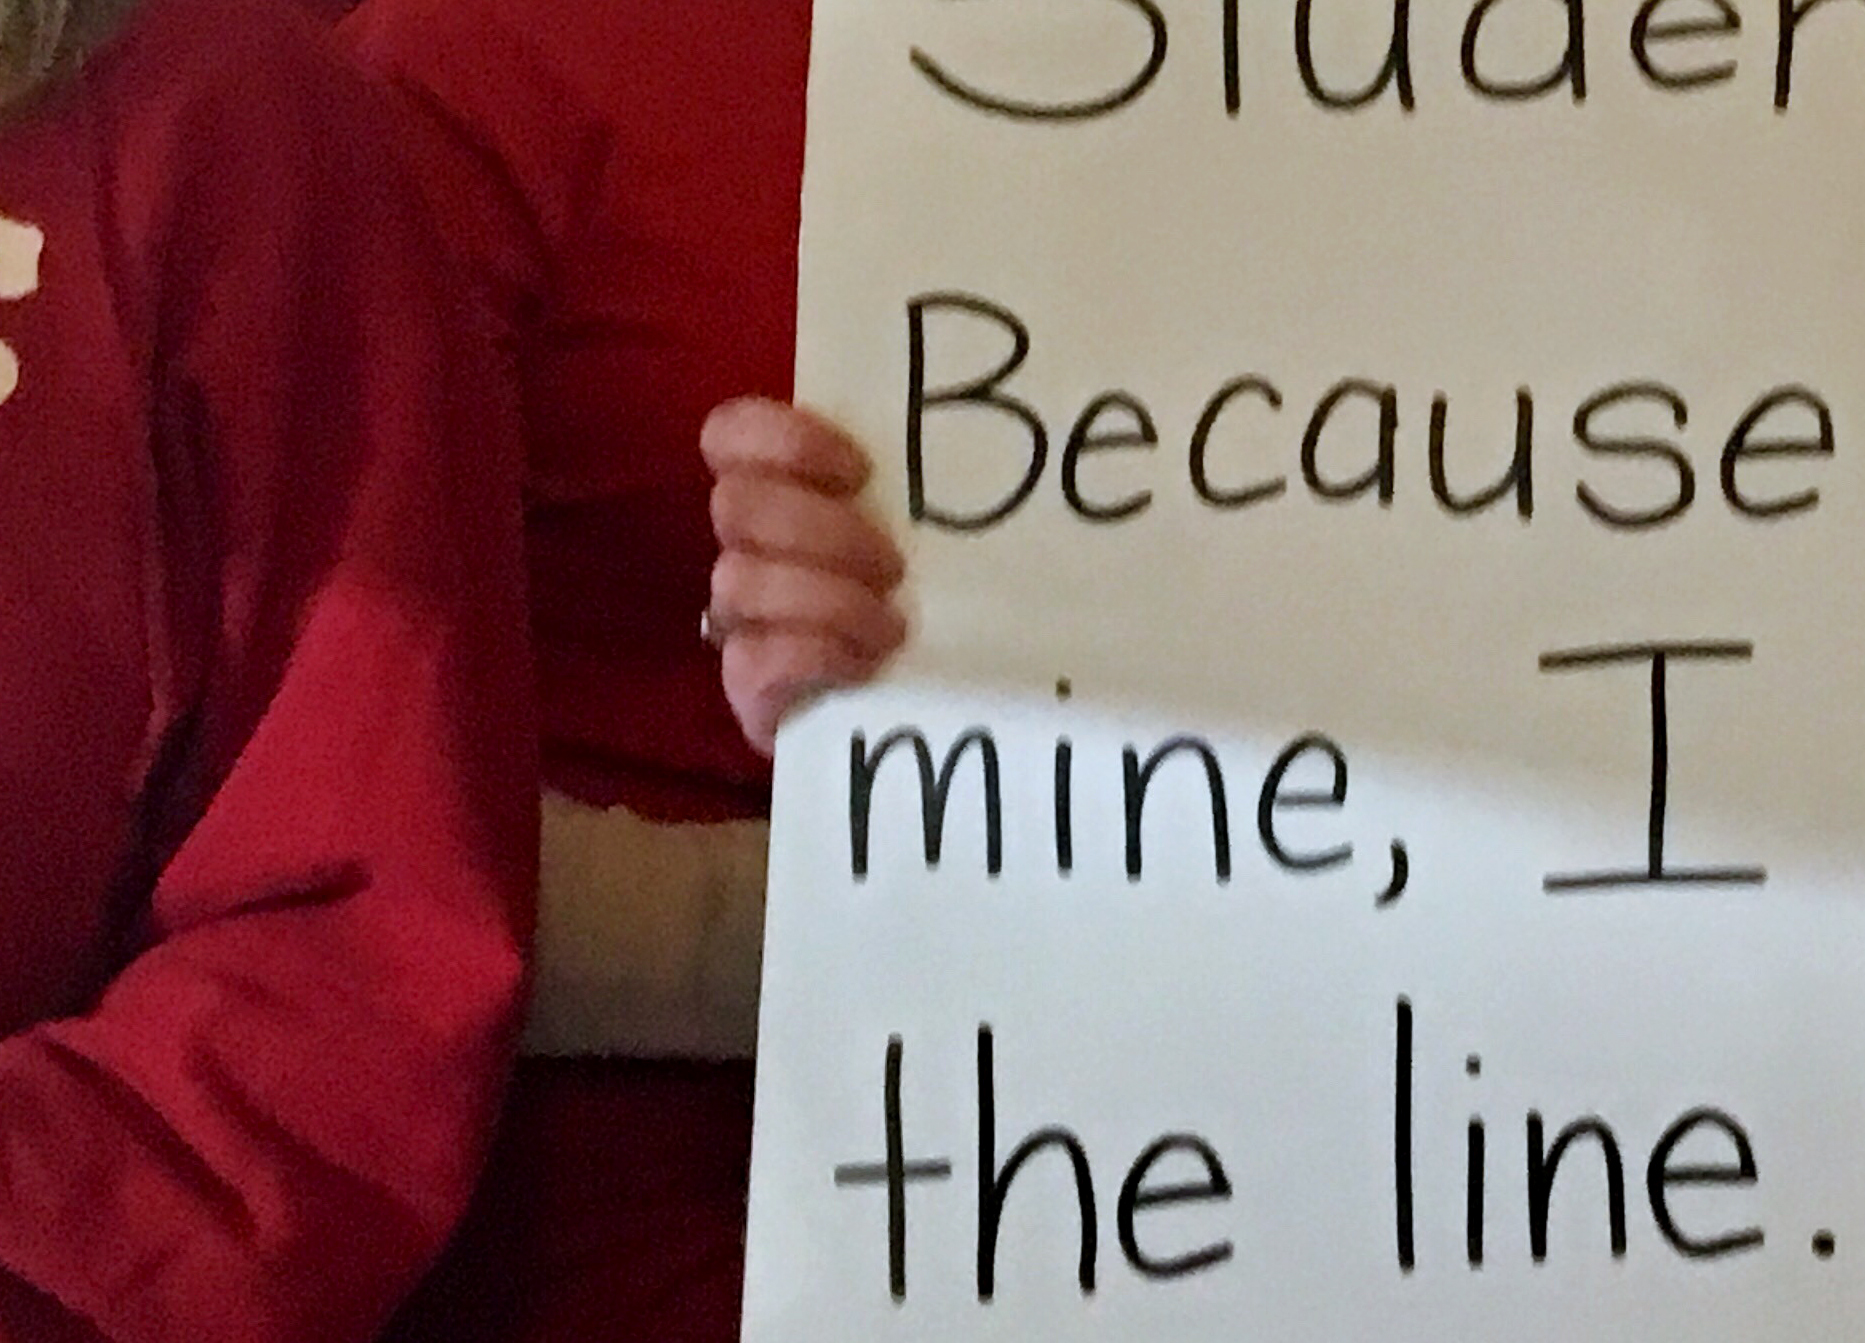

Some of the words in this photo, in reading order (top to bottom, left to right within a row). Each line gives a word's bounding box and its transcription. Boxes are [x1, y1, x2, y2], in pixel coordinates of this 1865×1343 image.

[907, 294, 1834, 532] Because
[850, 678, 1408, 905] mine,
[1539, 639, 1766, 892] I
[835, 1023, 1233, 1304] the
[1395, 996, 1835, 1274] line.
